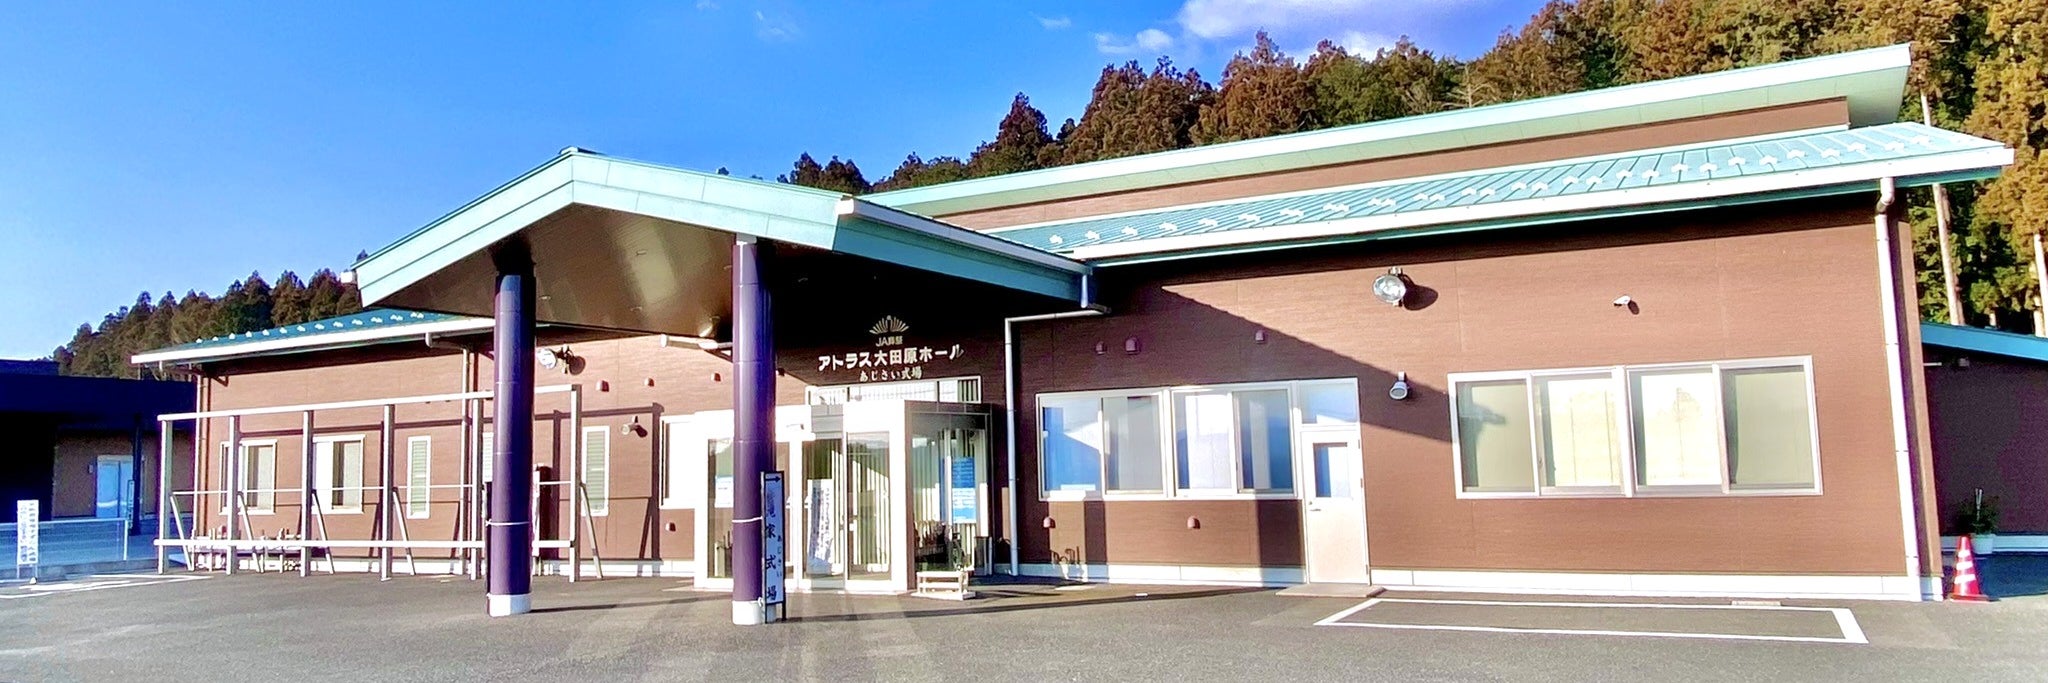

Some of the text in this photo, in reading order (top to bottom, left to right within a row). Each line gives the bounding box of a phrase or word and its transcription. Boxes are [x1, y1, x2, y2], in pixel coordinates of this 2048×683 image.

[818, 344, 964, 371] アトラス大田原ホール
[859, 366, 922, 382] あじさい式場
